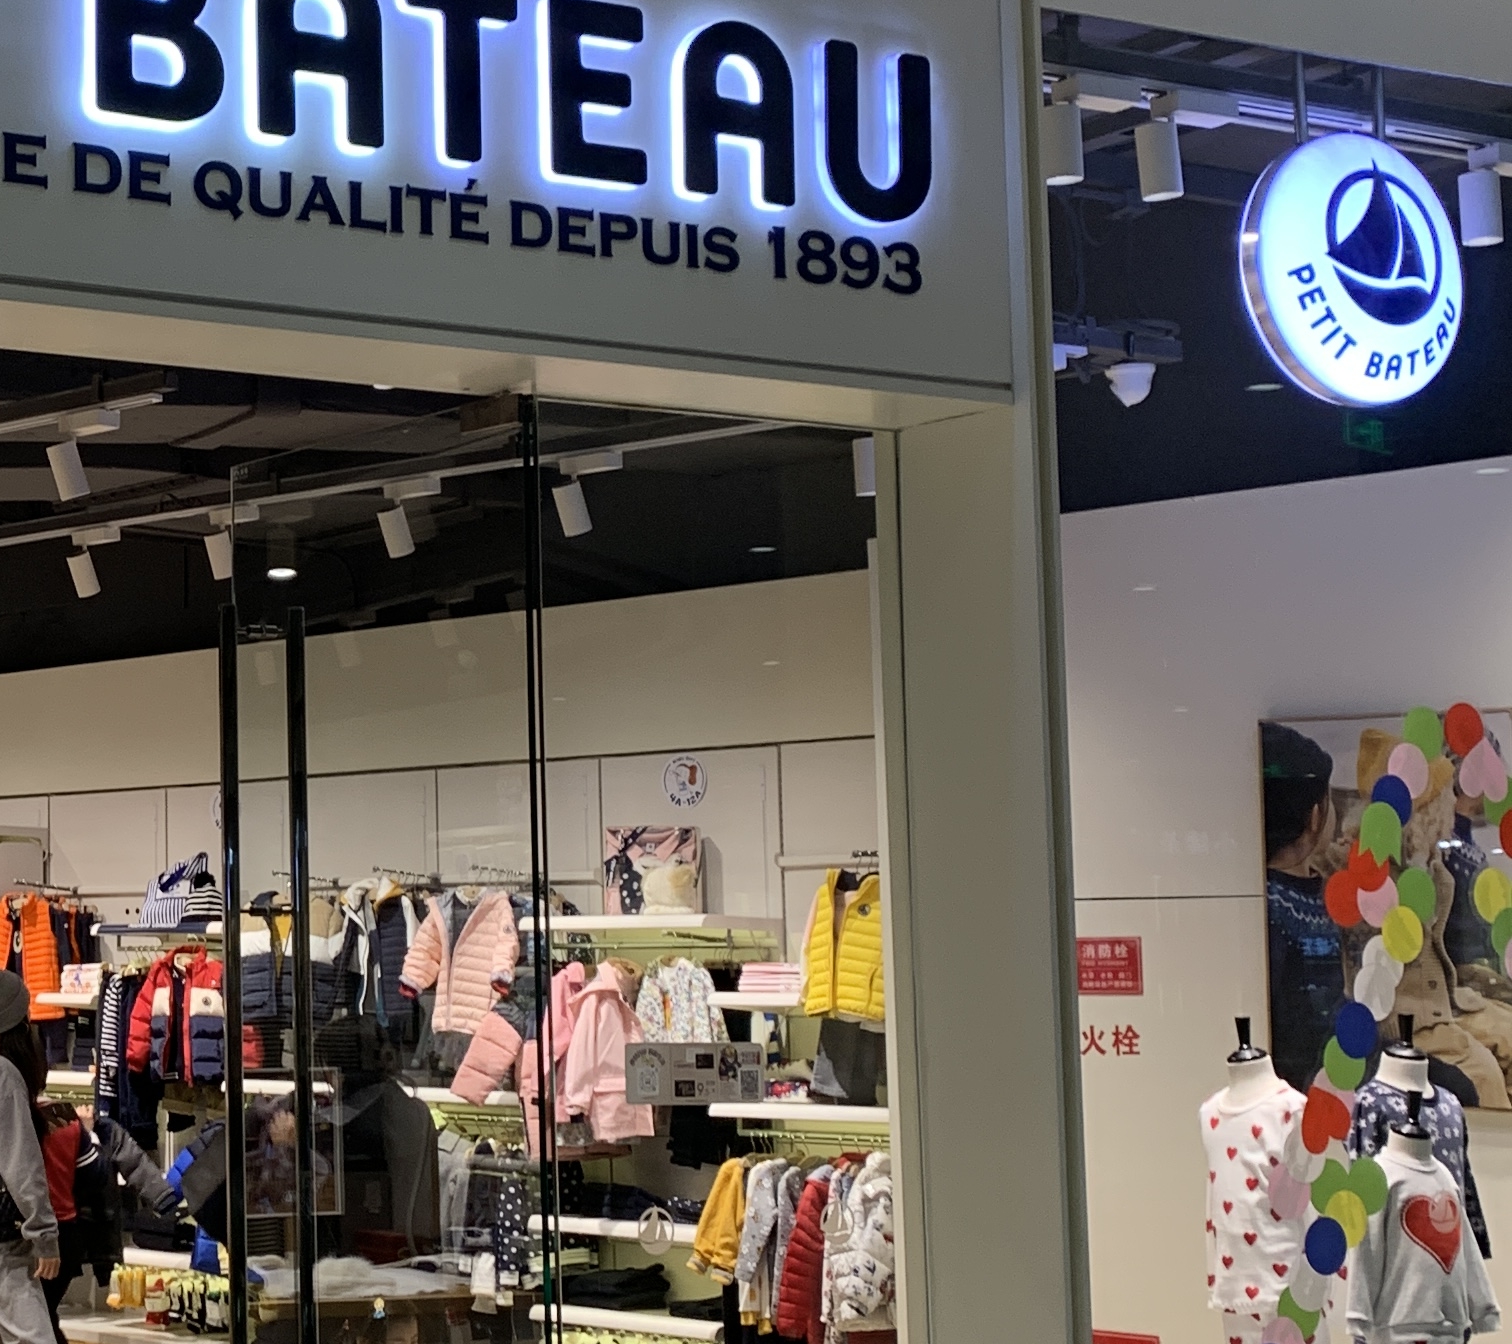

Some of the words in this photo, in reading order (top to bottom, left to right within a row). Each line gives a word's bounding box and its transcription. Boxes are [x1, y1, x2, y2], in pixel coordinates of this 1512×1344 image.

[72, 142, 172, 206] DE
[193, 162, 489, 245] QUALITÉ
[510, 199, 741, 273] DEPUIS
[769, 225, 923, 295] 1893
[1287, 262, 1358, 360] PETIT
[1364, 296, 1457, 381] BATEAU
[1080, 1024, 1141, 1056] 火栓
